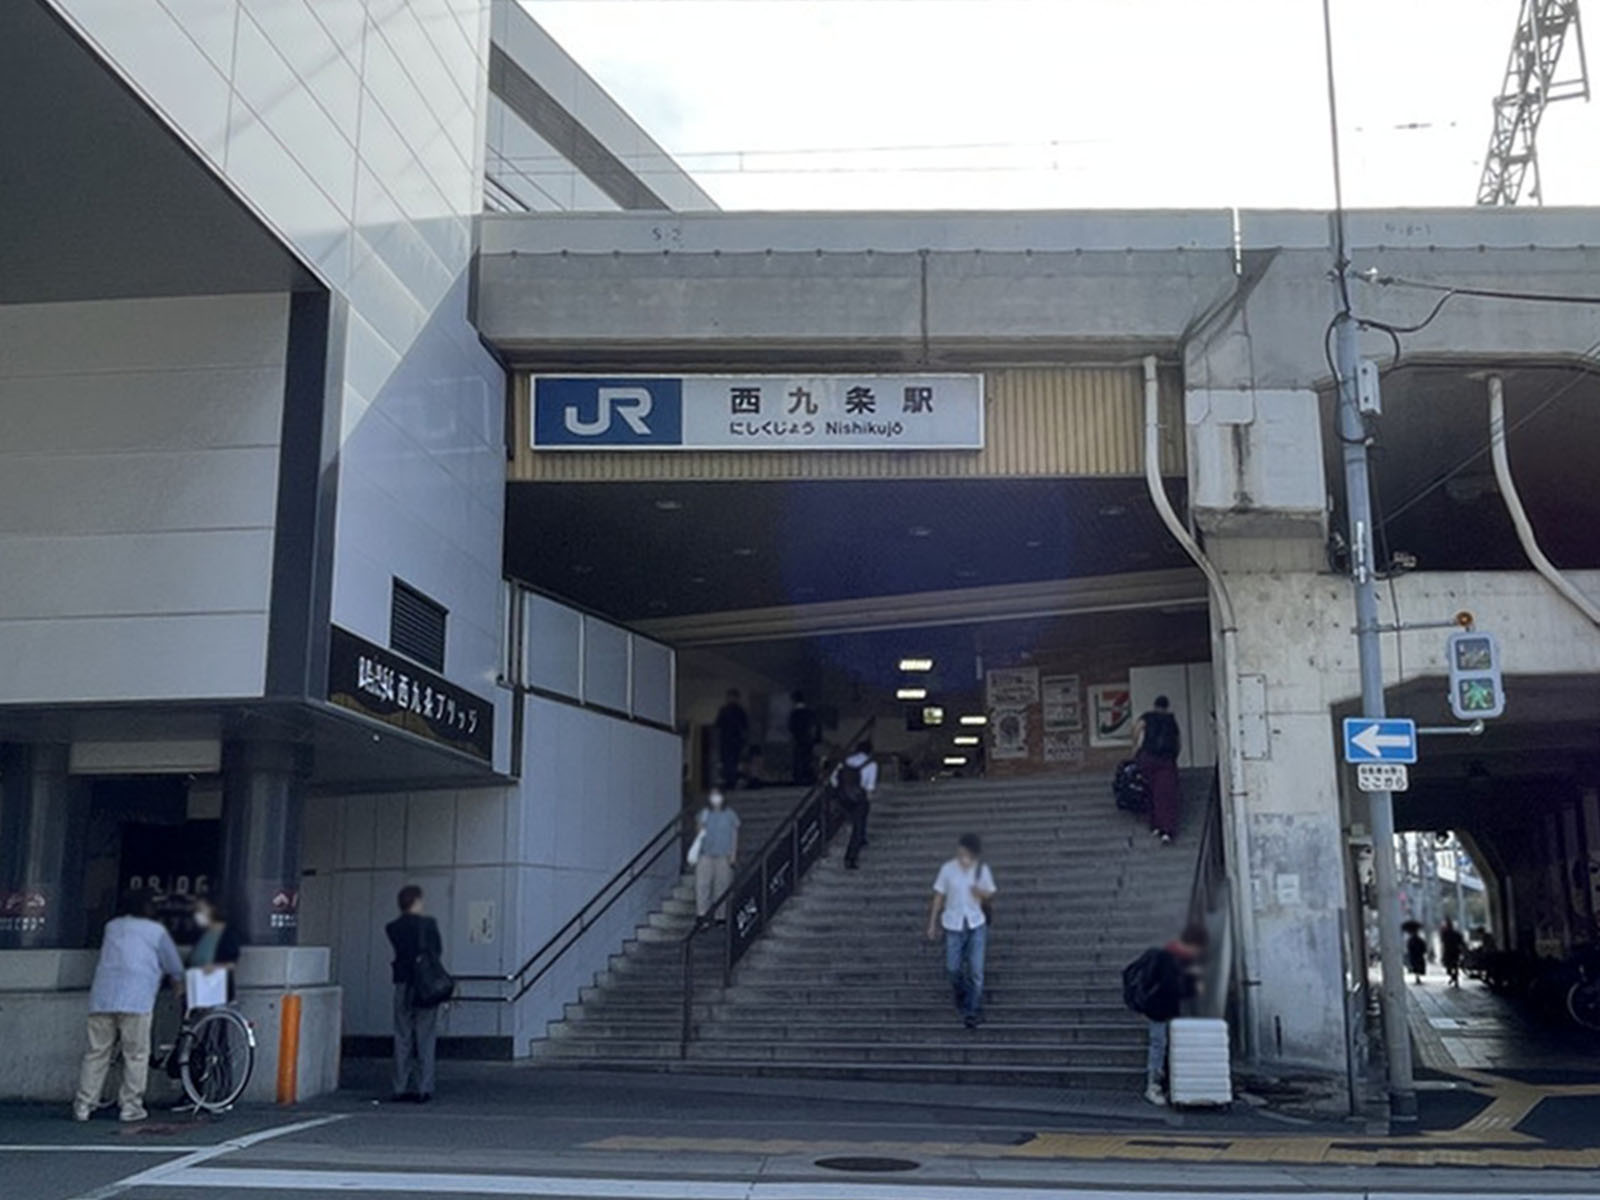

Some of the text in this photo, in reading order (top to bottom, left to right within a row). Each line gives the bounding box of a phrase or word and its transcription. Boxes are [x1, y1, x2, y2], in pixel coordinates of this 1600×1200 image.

[565, 387, 651, 435] JR
[730, 386, 934, 415] 西九条駅
[729, 421, 815, 436] にしくじょう
[1360, 775, 1406, 789] ここから
